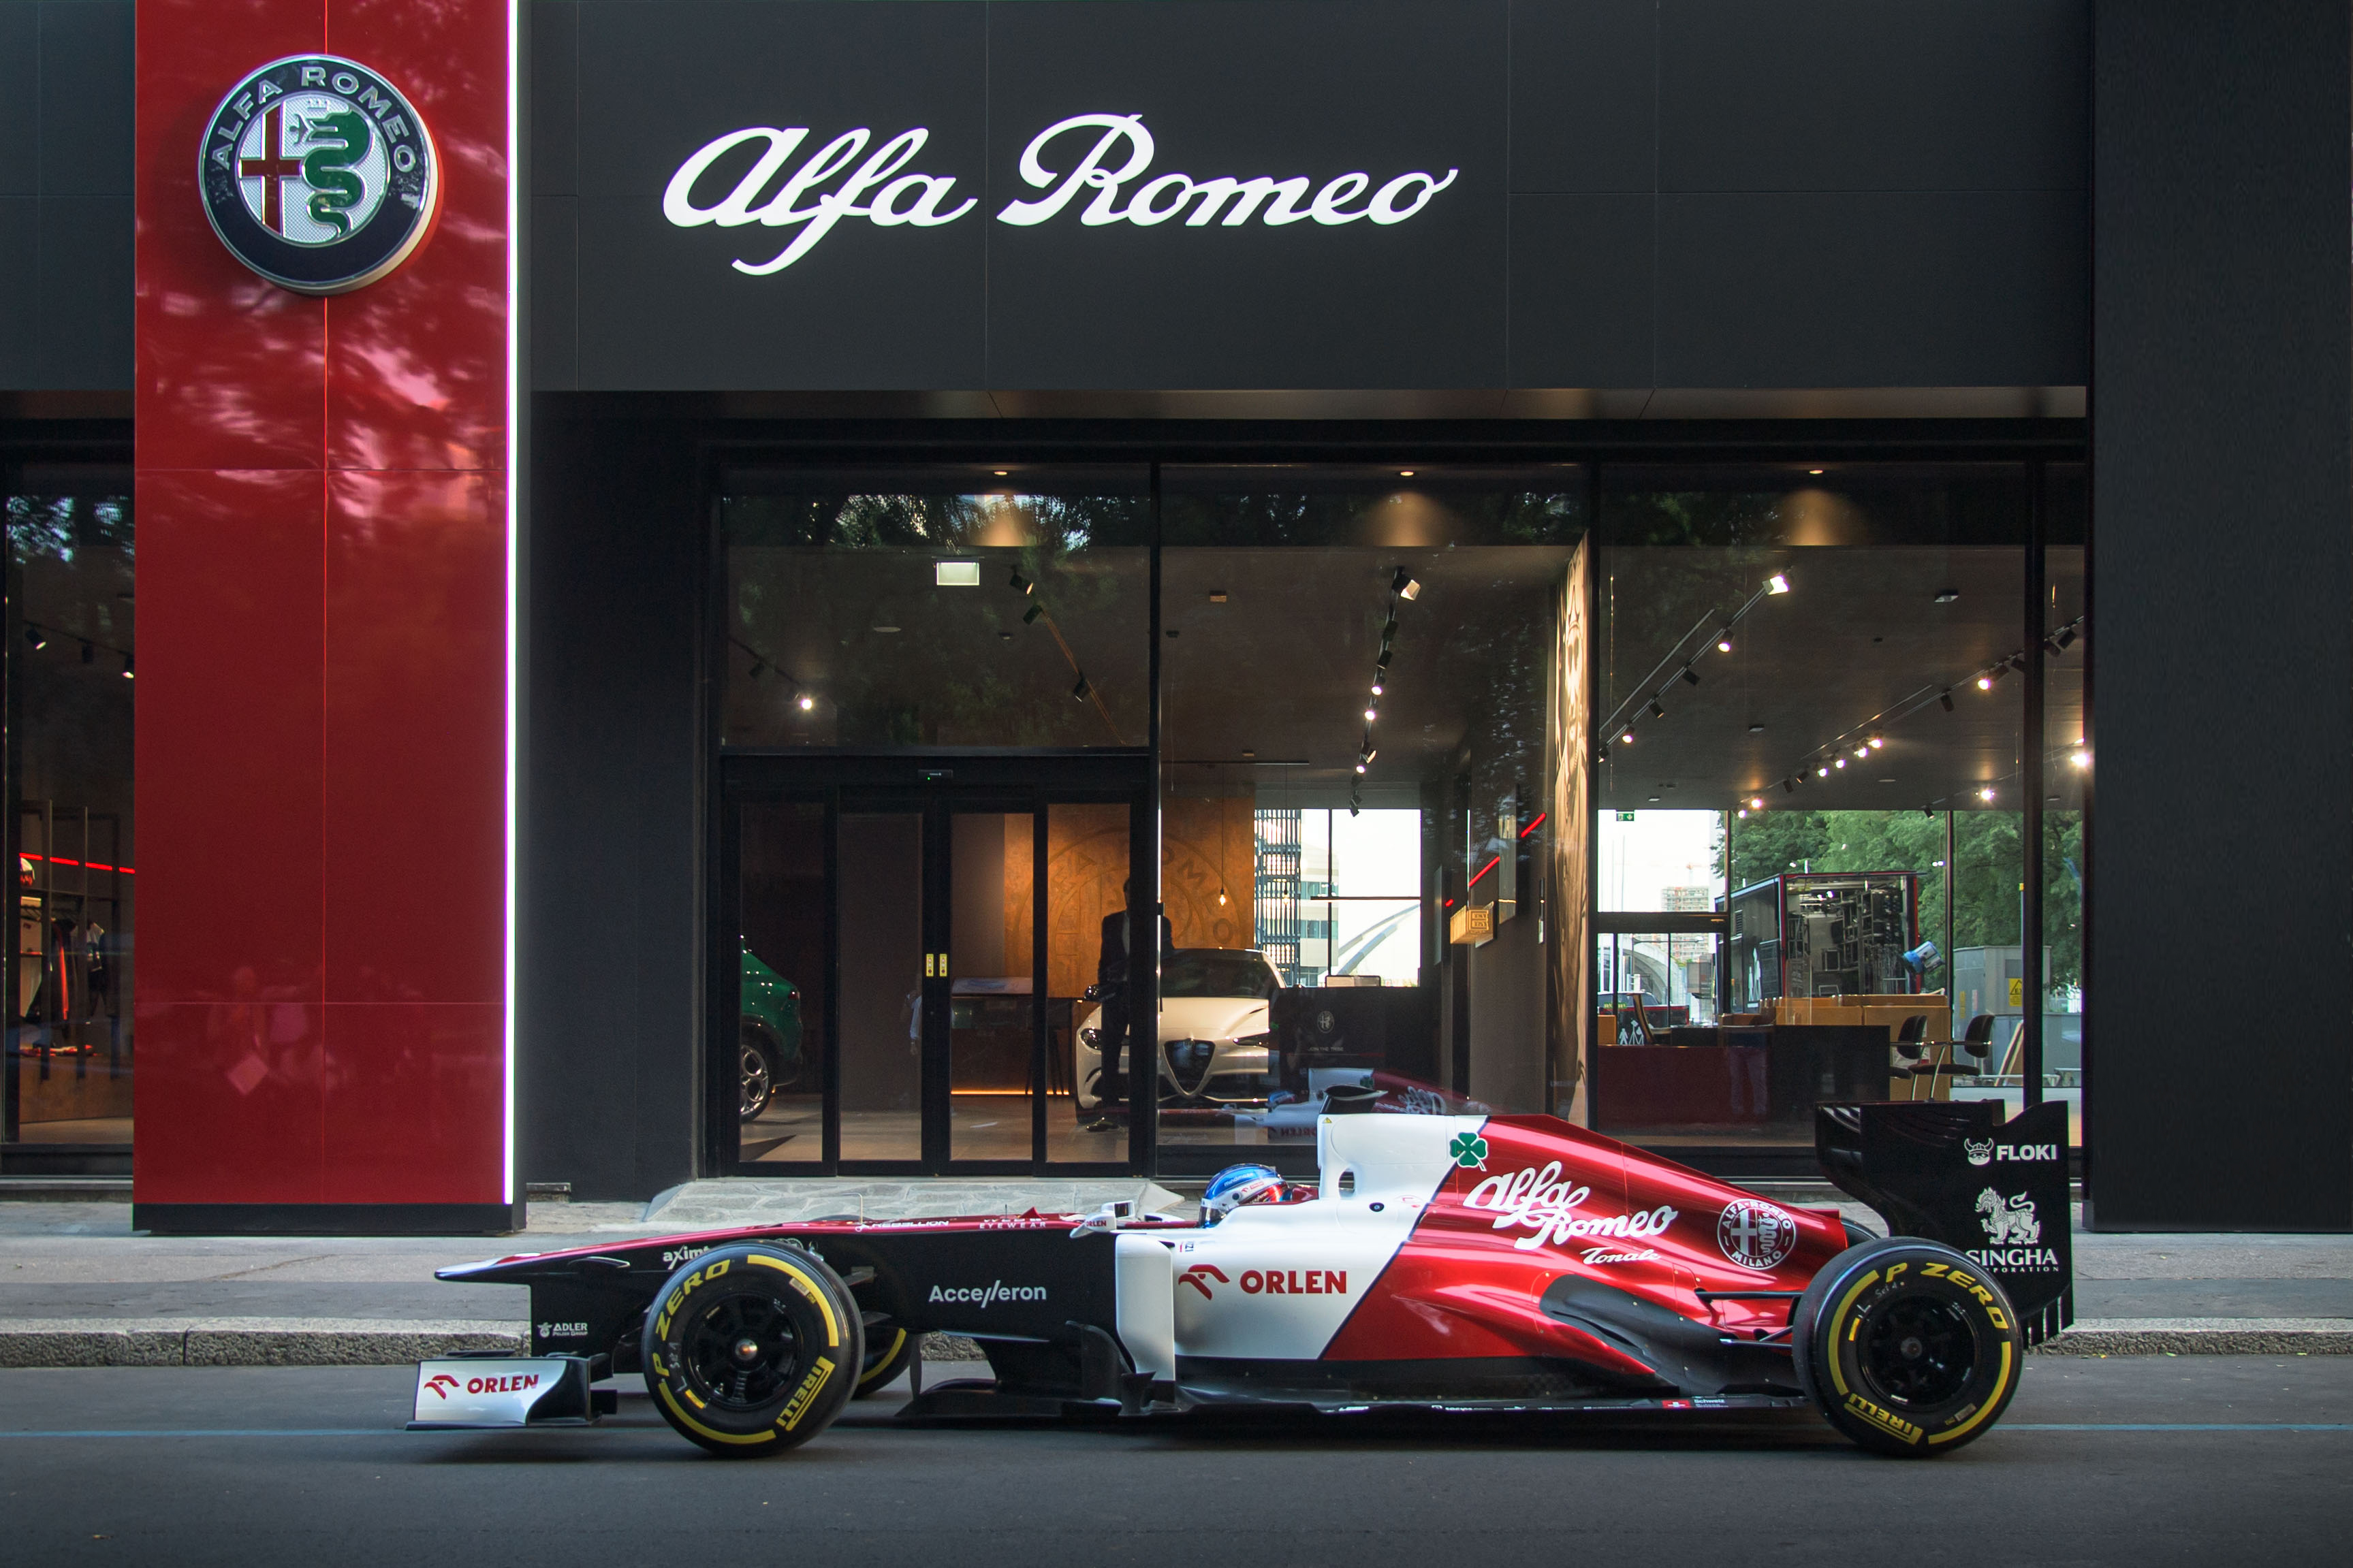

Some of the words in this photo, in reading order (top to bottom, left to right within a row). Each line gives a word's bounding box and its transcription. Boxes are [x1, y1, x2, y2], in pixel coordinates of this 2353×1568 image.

[212, 78, 283, 171] ALFA
[301, 65, 417, 173] ROMEO
[663, 127, 979, 276] Alfa
[996, 113, 1459, 227] Romeo
[1996, 1144, 2057, 1161] FLOKI
[1462, 1159, 1590, 1229] Alfa
[1513, 1204, 1679, 1251] Romeo
[1579, 1247, 1662, 1264] Tonale
[1731, 1250, 1782, 1267] MILANO
[1965, 1248, 2059, 1266] SINGHA
[654, 1258, 731, 1342] ZERO
[1239, 1270, 1348, 1295] ORLEN
[1886, 1262, 1908, 1283] P
[1920, 1262, 2010, 1330] ZERO
[552, 1322, 588, 1332] ADLER
[652, 1352, 670, 1377] P
[467, 1375, 539, 1394] ORLEN
[775, 1356, 836, 1431] PIRELLI
[1844, 1392, 1923, 1445] PIRELLI
